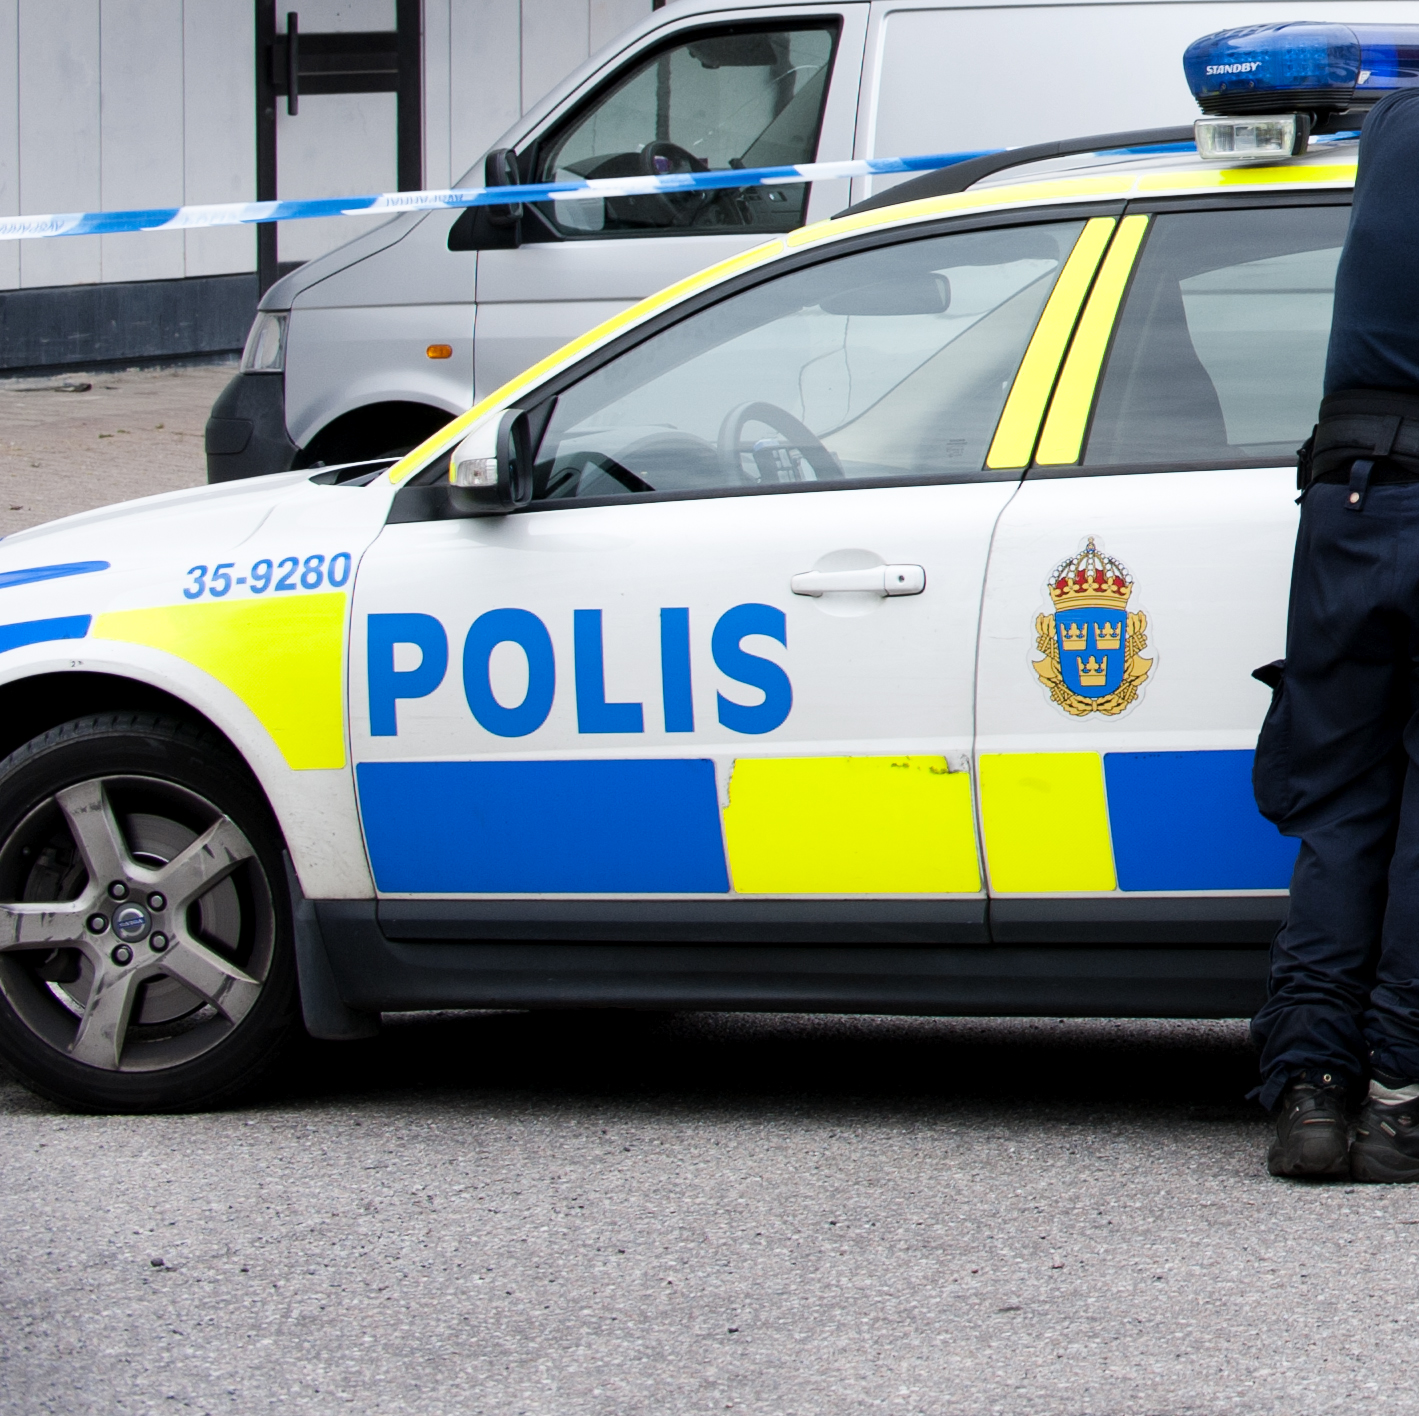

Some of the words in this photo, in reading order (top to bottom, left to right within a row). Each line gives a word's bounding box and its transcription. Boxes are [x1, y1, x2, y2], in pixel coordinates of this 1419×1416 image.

[1206, 62, 1261, 75] STANDBY
[183, 551, 352, 600] 35-9280
[367, 603, 793, 738] POLIS
